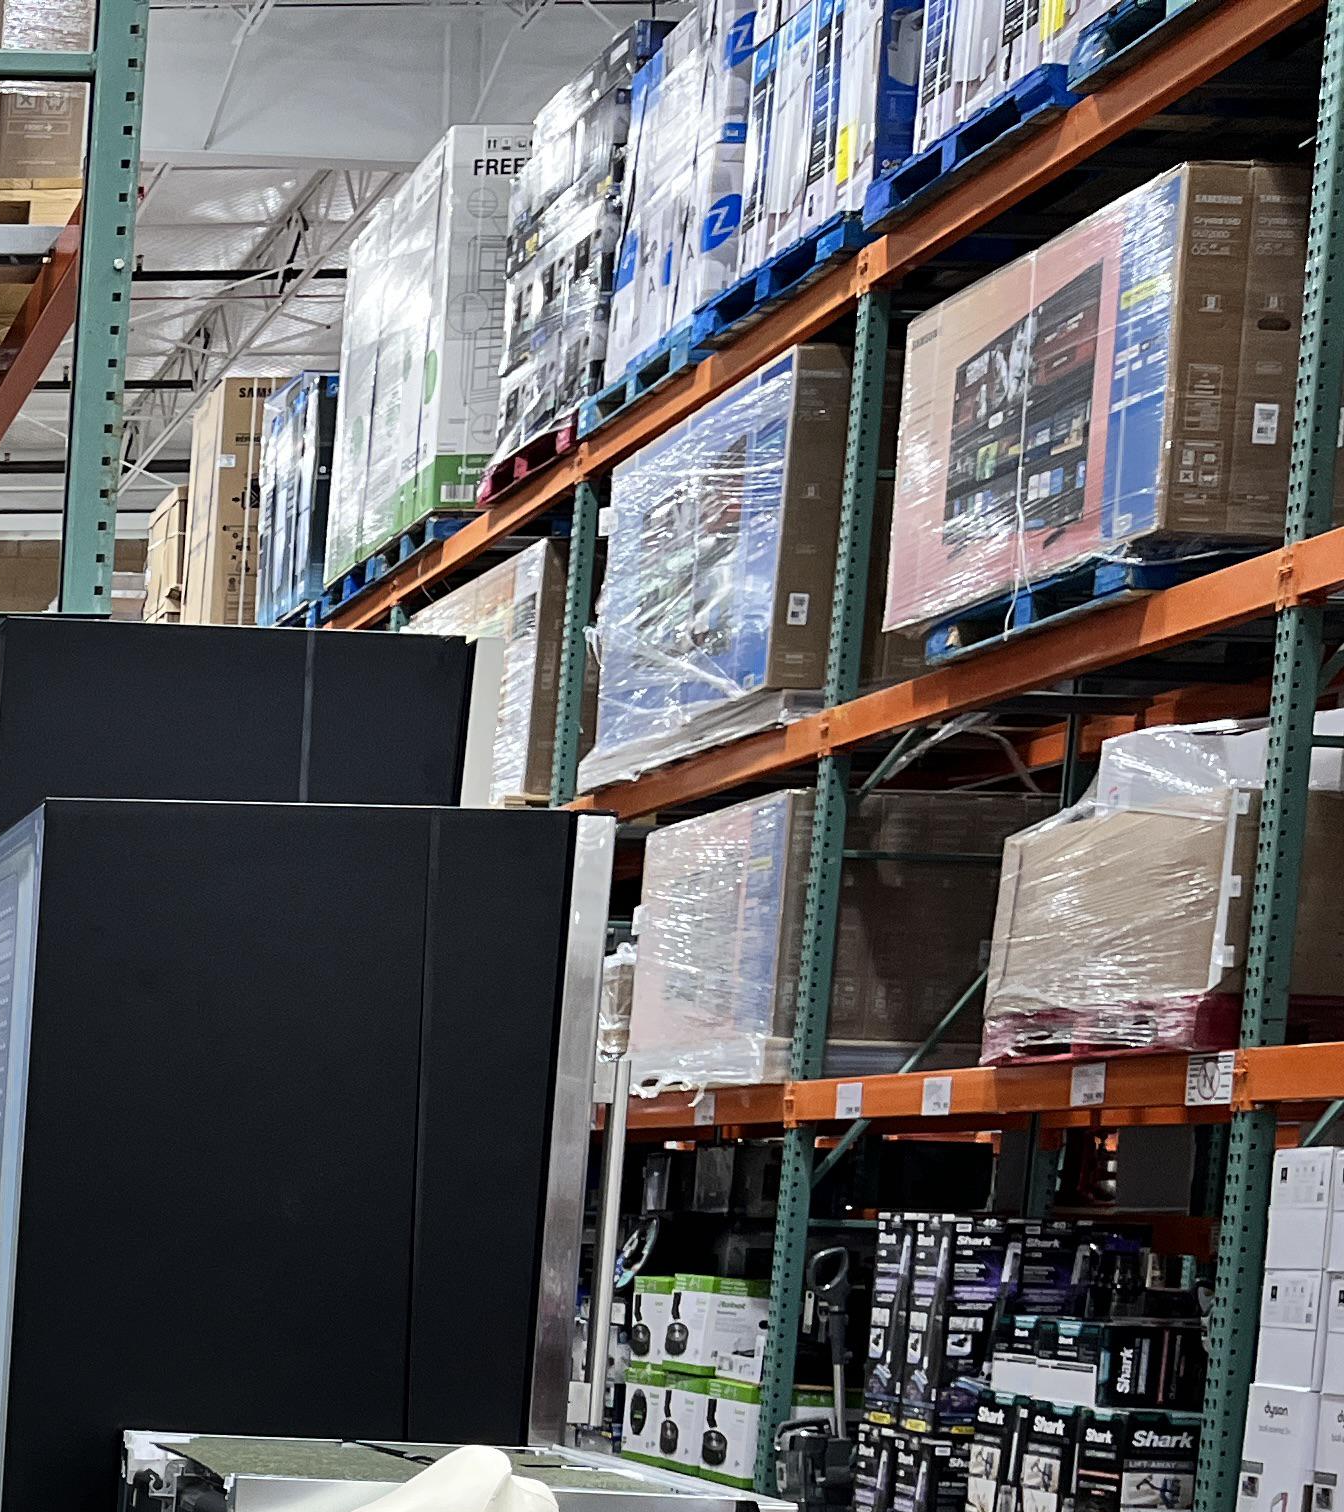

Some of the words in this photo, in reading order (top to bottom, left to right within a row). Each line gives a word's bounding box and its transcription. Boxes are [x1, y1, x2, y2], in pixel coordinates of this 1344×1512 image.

[473, 158, 531, 176] FREE
[956, 1236, 992, 1246] Shark
[1025, 1238, 1060, 1248] Shark
[1116, 1346, 1134, 1394] Shark
[977, 1407, 1005, 1425] Shark
[1264, 1400, 1289, 1418] dyson
[1033, 1415, 1066, 1436] Shark
[1085, 1427, 1113, 1445] Shark
[1131, 1430, 1194, 1449] Shark
